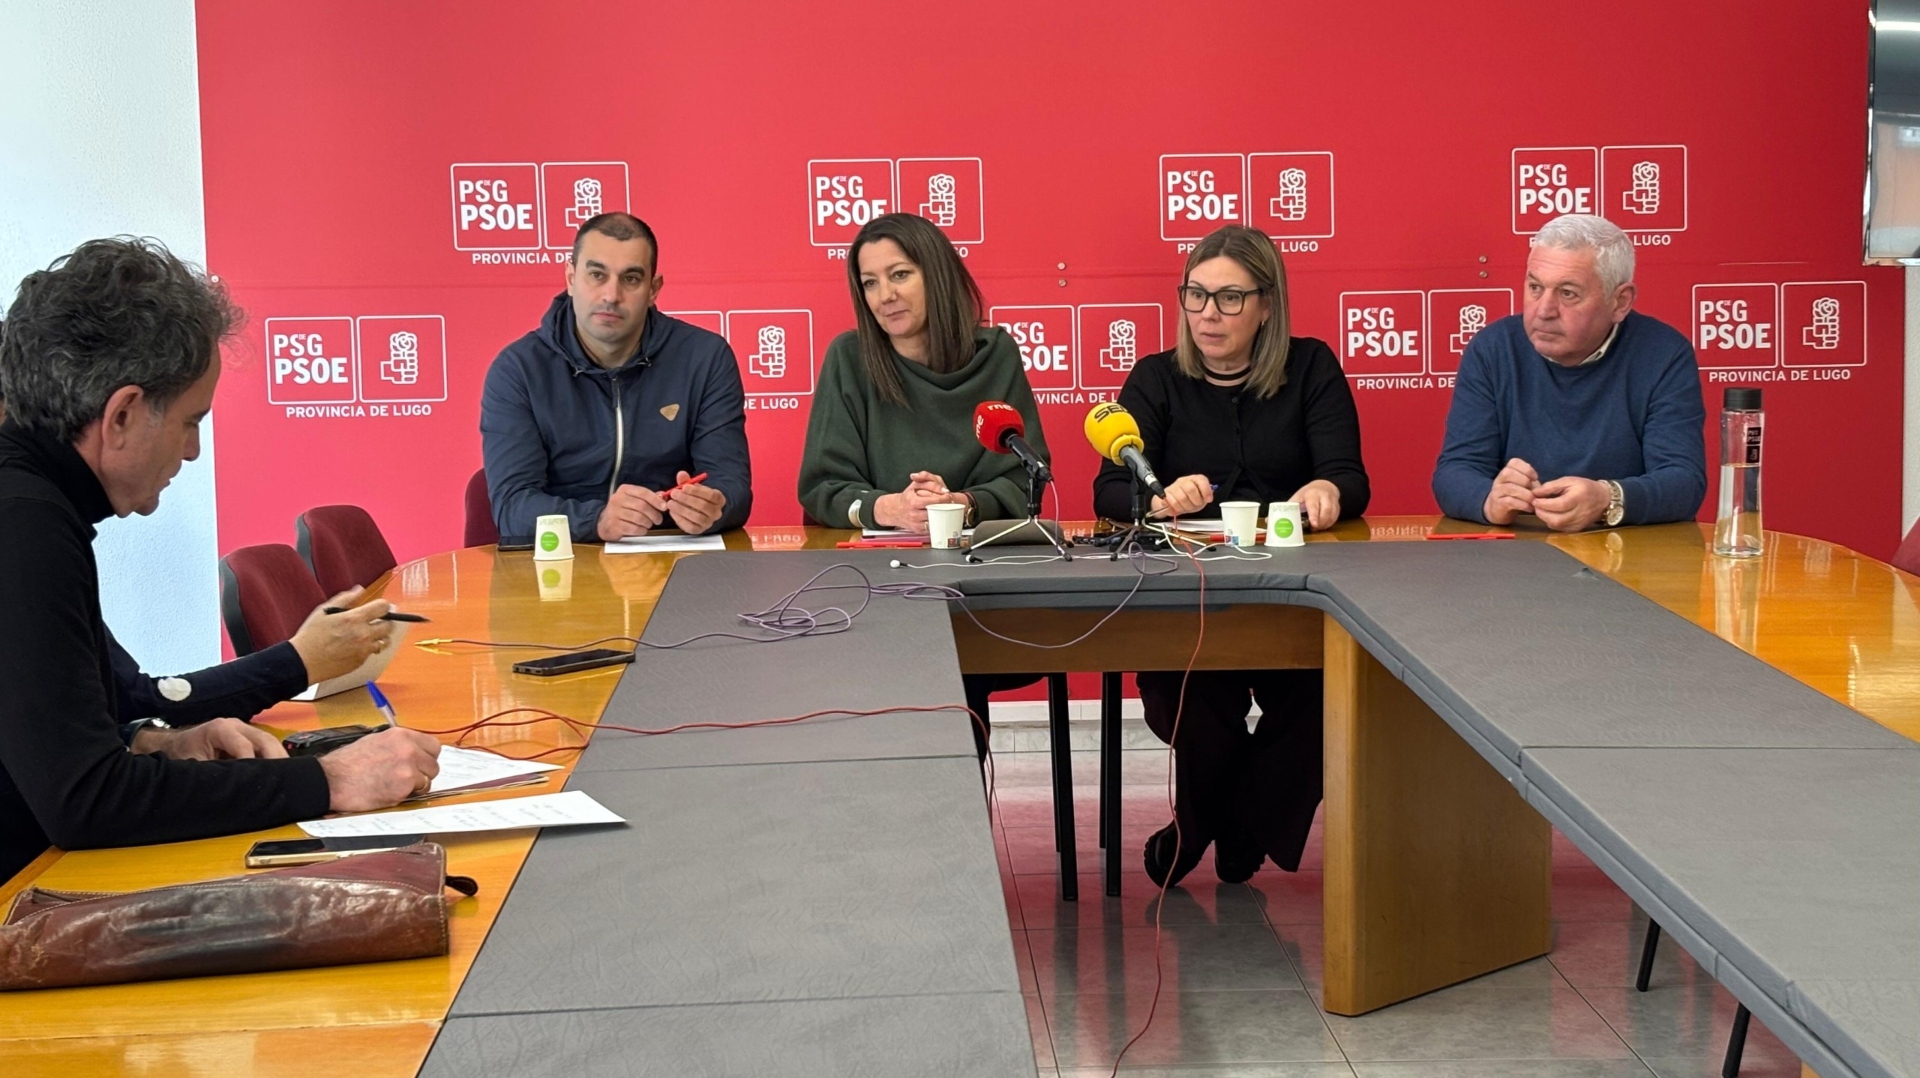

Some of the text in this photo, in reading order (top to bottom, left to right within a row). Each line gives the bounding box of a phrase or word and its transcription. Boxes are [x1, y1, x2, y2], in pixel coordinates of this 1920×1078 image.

[816, 176, 863, 198] PSG
[1167, 170, 1214, 193] PSG
[1519, 164, 1567, 187] PSG
[459, 180, 508, 202] PSG
[1520, 188, 1591, 214] PSOE
[460, 203, 534, 230] PSOE
[1168, 194, 1239, 221] PSOE
[1281, 241, 1319, 253] LUGO
[1633, 234, 1671, 246] LUGO
[472, 252, 551, 265] PROVINCIA
[1347, 307, 1394, 330] PSG
[1700, 300, 1747, 323] PSG
[274, 333, 323, 357] PSG
[1348, 330, 1418, 357] PSOE
[1700, 323, 1771, 350] PSOE
[1018, 345, 1069, 372] SOE
[275, 357, 348, 384] PSOE
[1709, 369, 1851, 382] PROVINCIA DE LUGO
[1357, 377, 1456, 390] PROVINCIA DE
[761, 398, 799, 410] LUGO
[1034, 392, 1085, 404] VINCIA
[1089, 392, 1107, 403] DE
[286, 404, 432, 418] PROVINCIA DE LUGO
